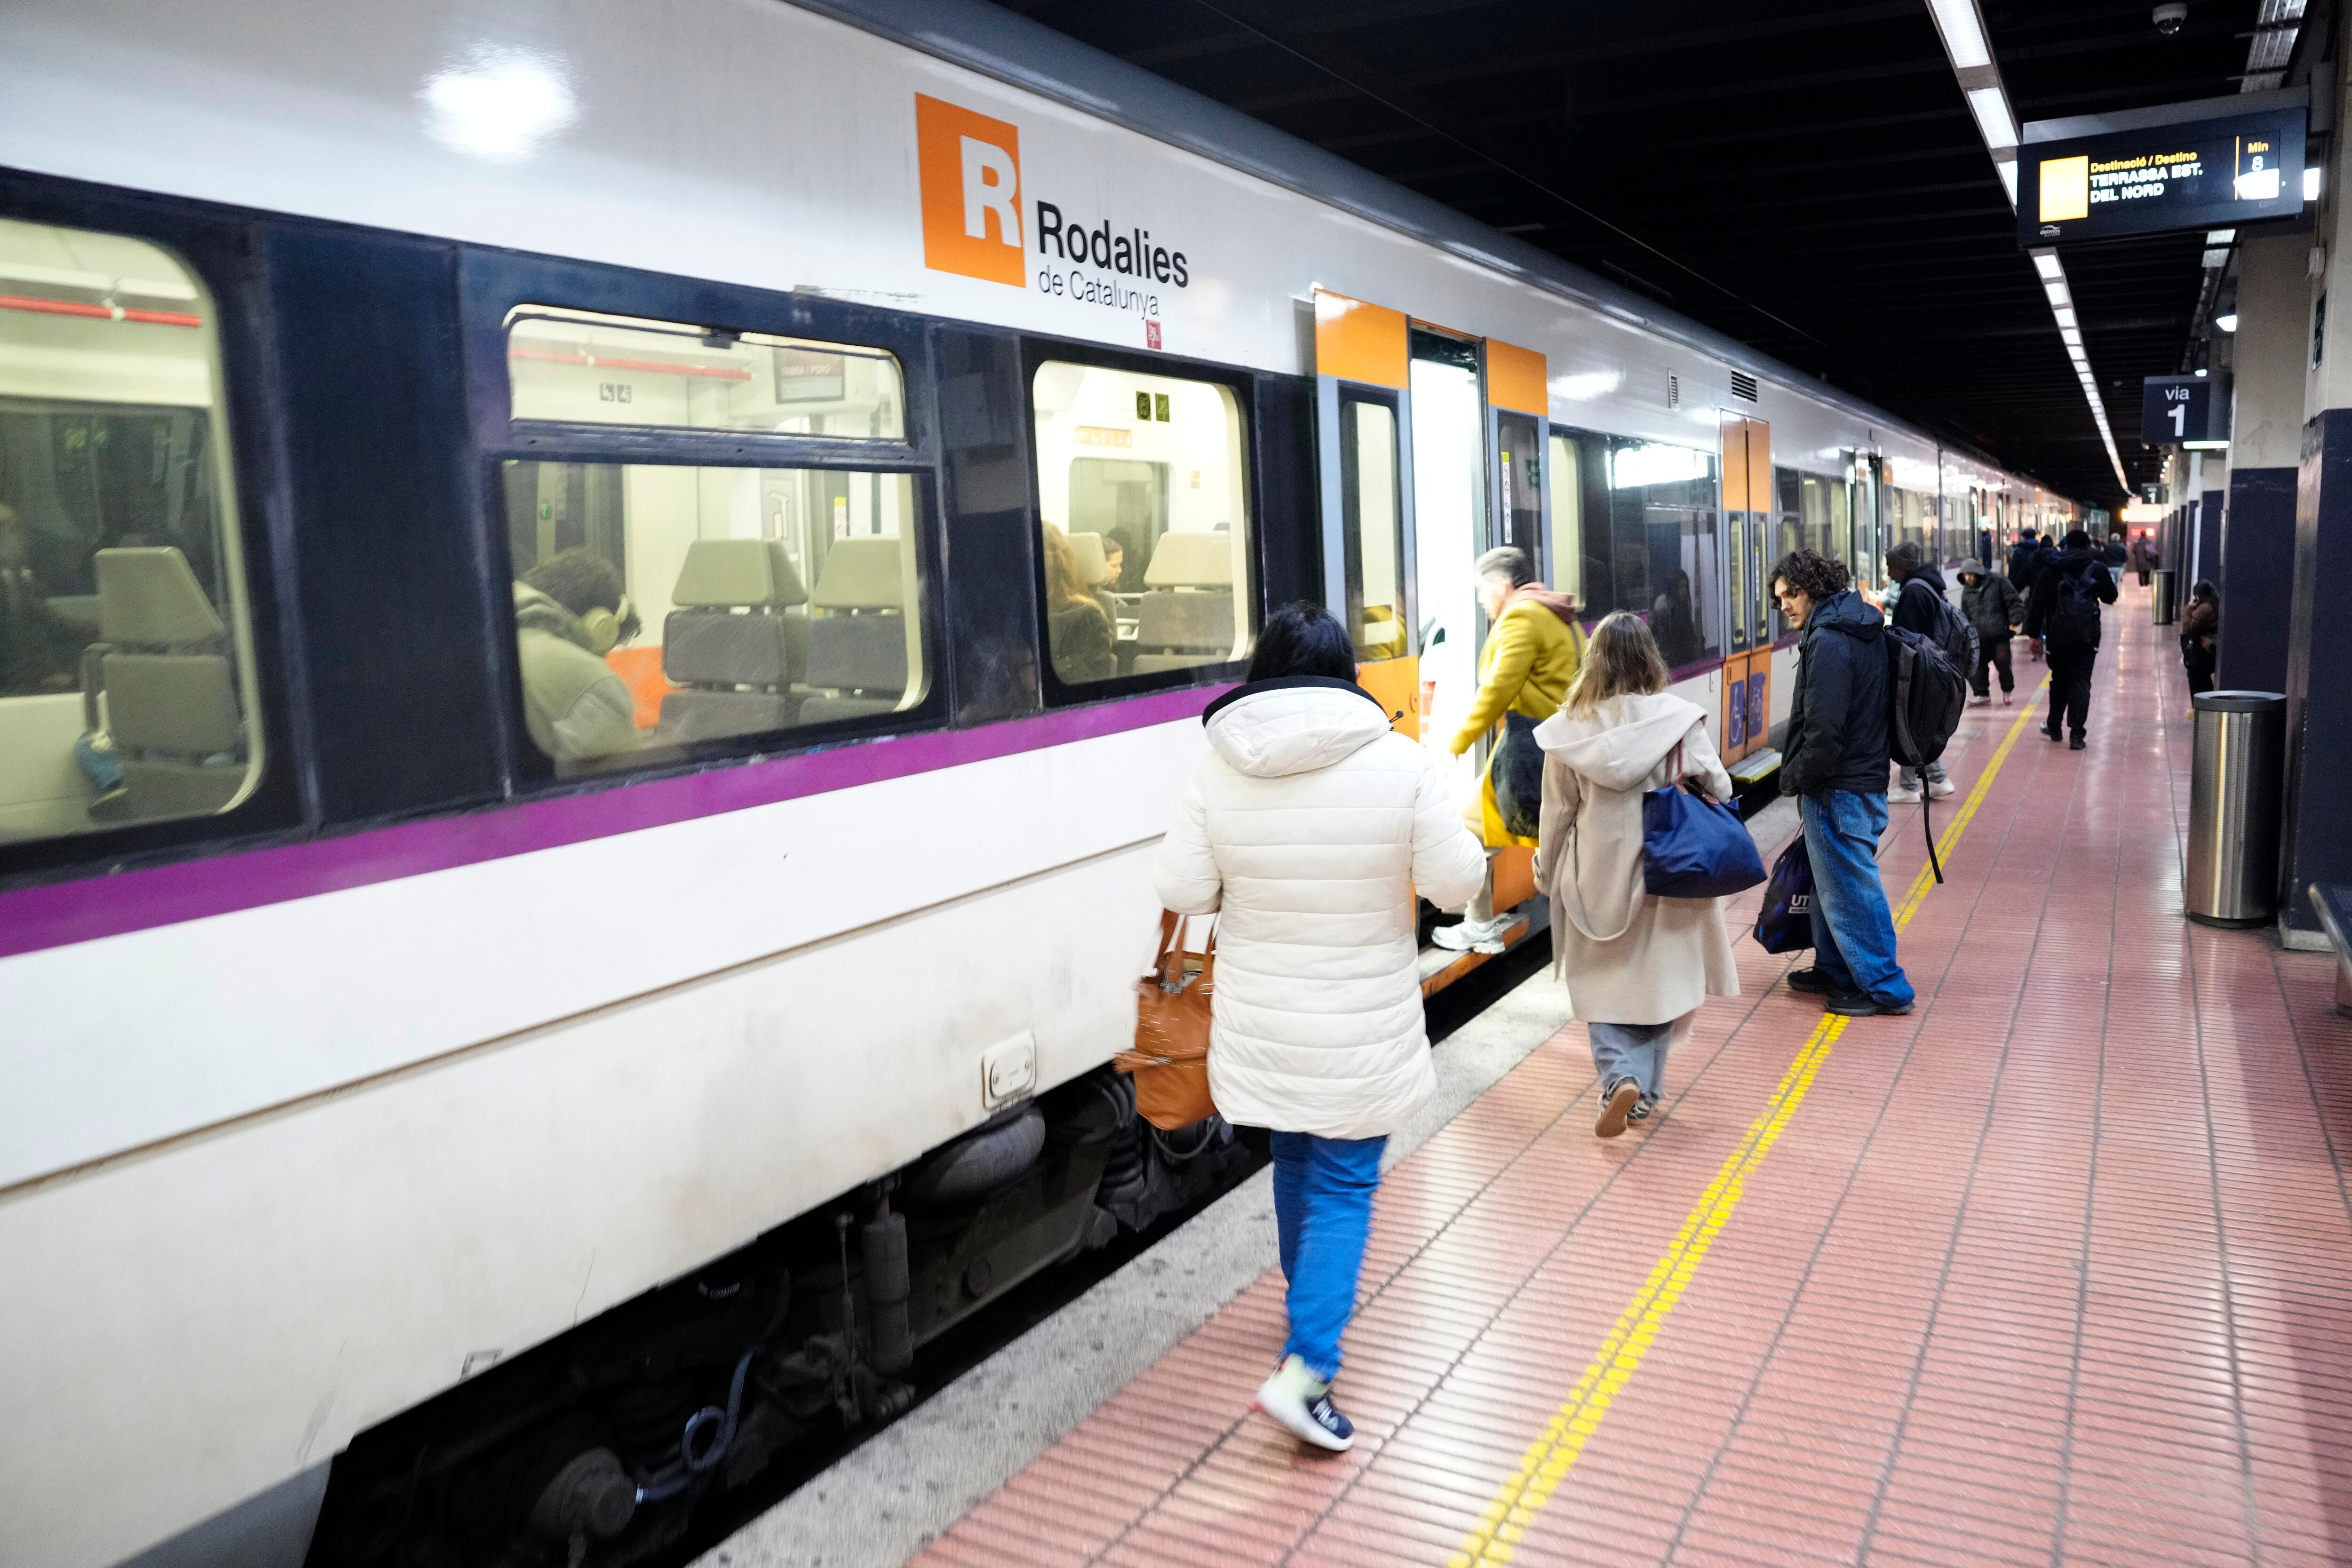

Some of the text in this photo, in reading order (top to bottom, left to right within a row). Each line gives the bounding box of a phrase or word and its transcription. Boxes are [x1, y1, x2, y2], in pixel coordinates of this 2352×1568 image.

[2248, 142, 2269, 154] Min
[2090, 156, 2147, 173] Destinació
[2155, 151, 2198, 165] Destino
[2090, 162, 2203, 188] TERRASSA EST.
[960, 135, 1022, 248] R
[2090, 183, 2164, 203] DEL NORD
[1037, 200, 1188, 288] Rodalies
[1039, 264, 1160, 320] de Catalunya
[2165, 385, 2190, 400] via
[2167, 404, 2185, 437] 1
[1791, 894, 1810, 906] UT
